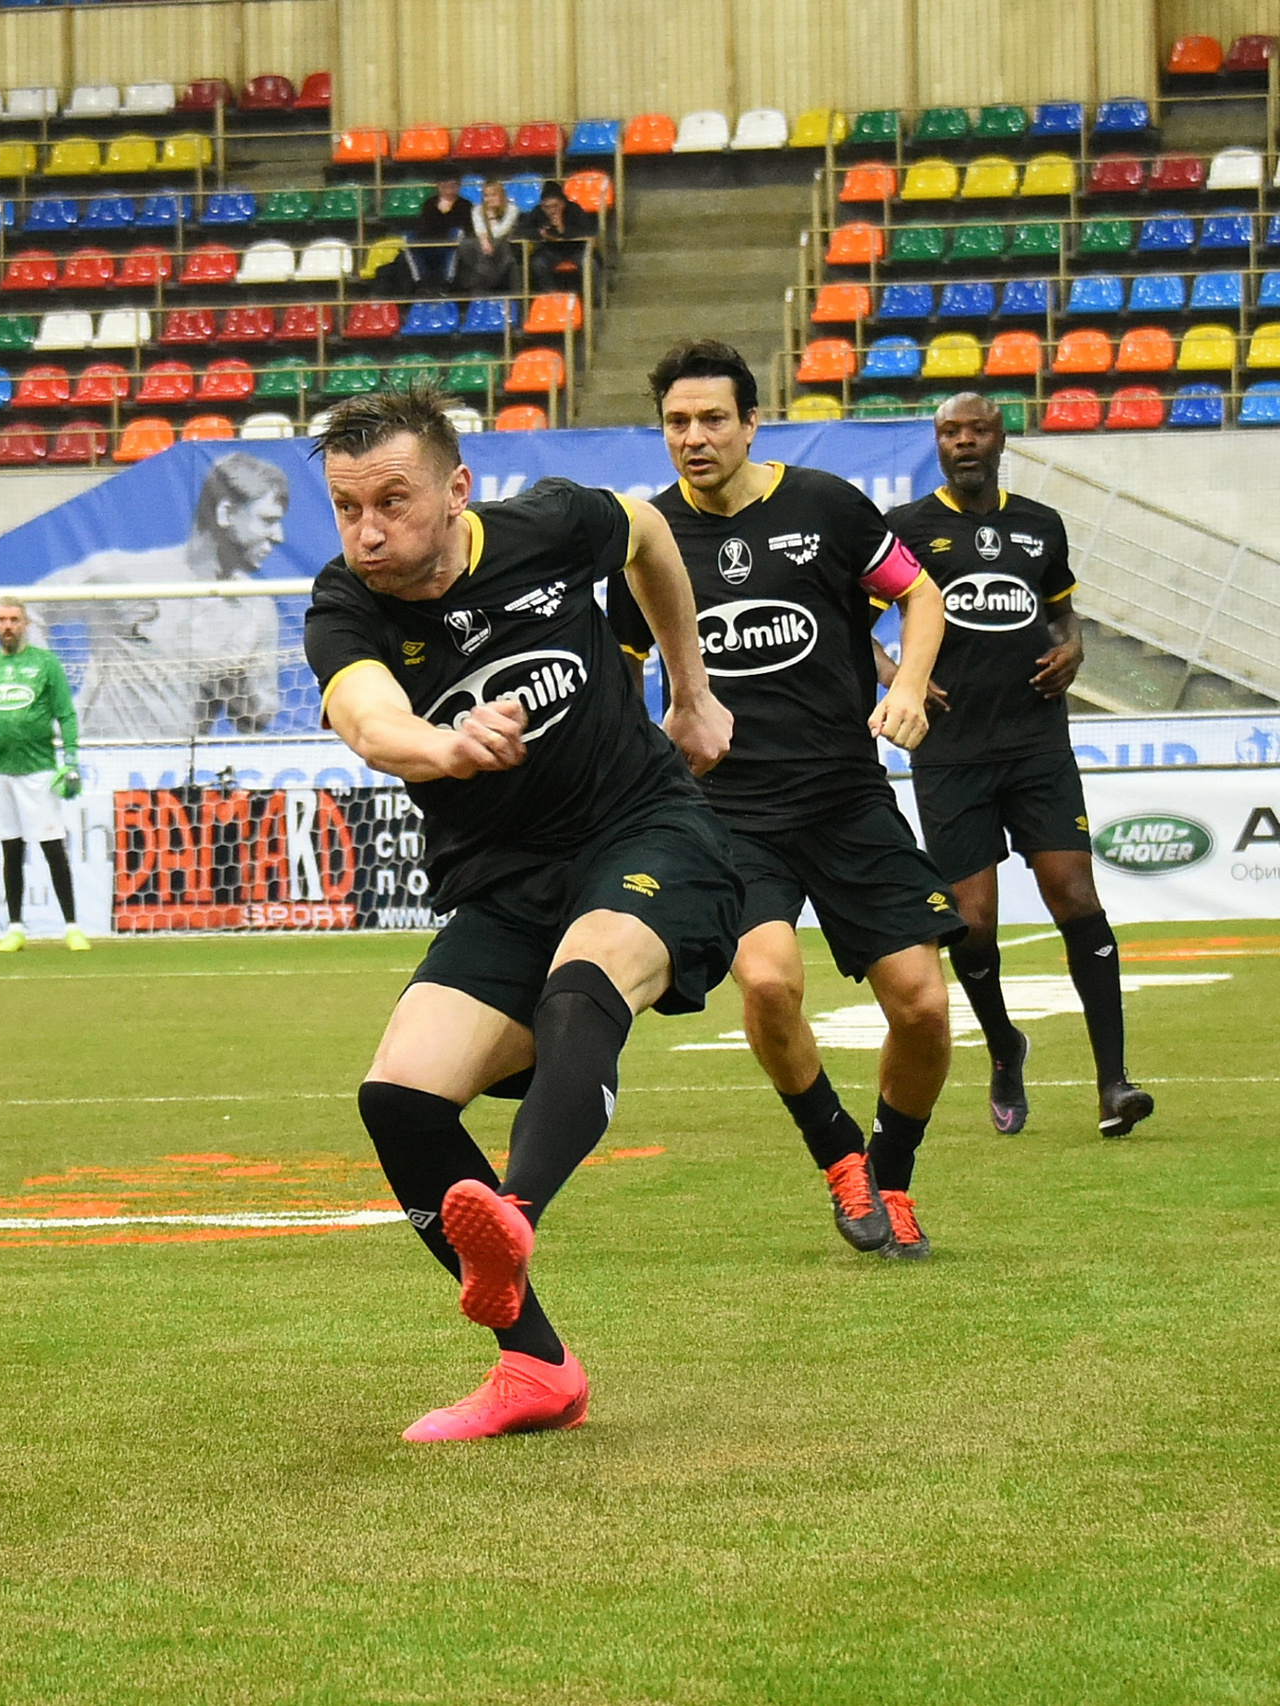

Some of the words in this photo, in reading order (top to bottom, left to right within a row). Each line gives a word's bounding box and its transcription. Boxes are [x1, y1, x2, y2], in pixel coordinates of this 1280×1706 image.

[945, 588, 1032, 613] ecomilk
[375, 794, 424, 819] ПР
[1112, 824, 1174, 844] LAND
[1119, 843, 1194, 864] ROVER
[1231, 863, 1280, 883] Офи
[623, 882, 654, 897] umbro
[243, 904, 354, 927] SPORT
